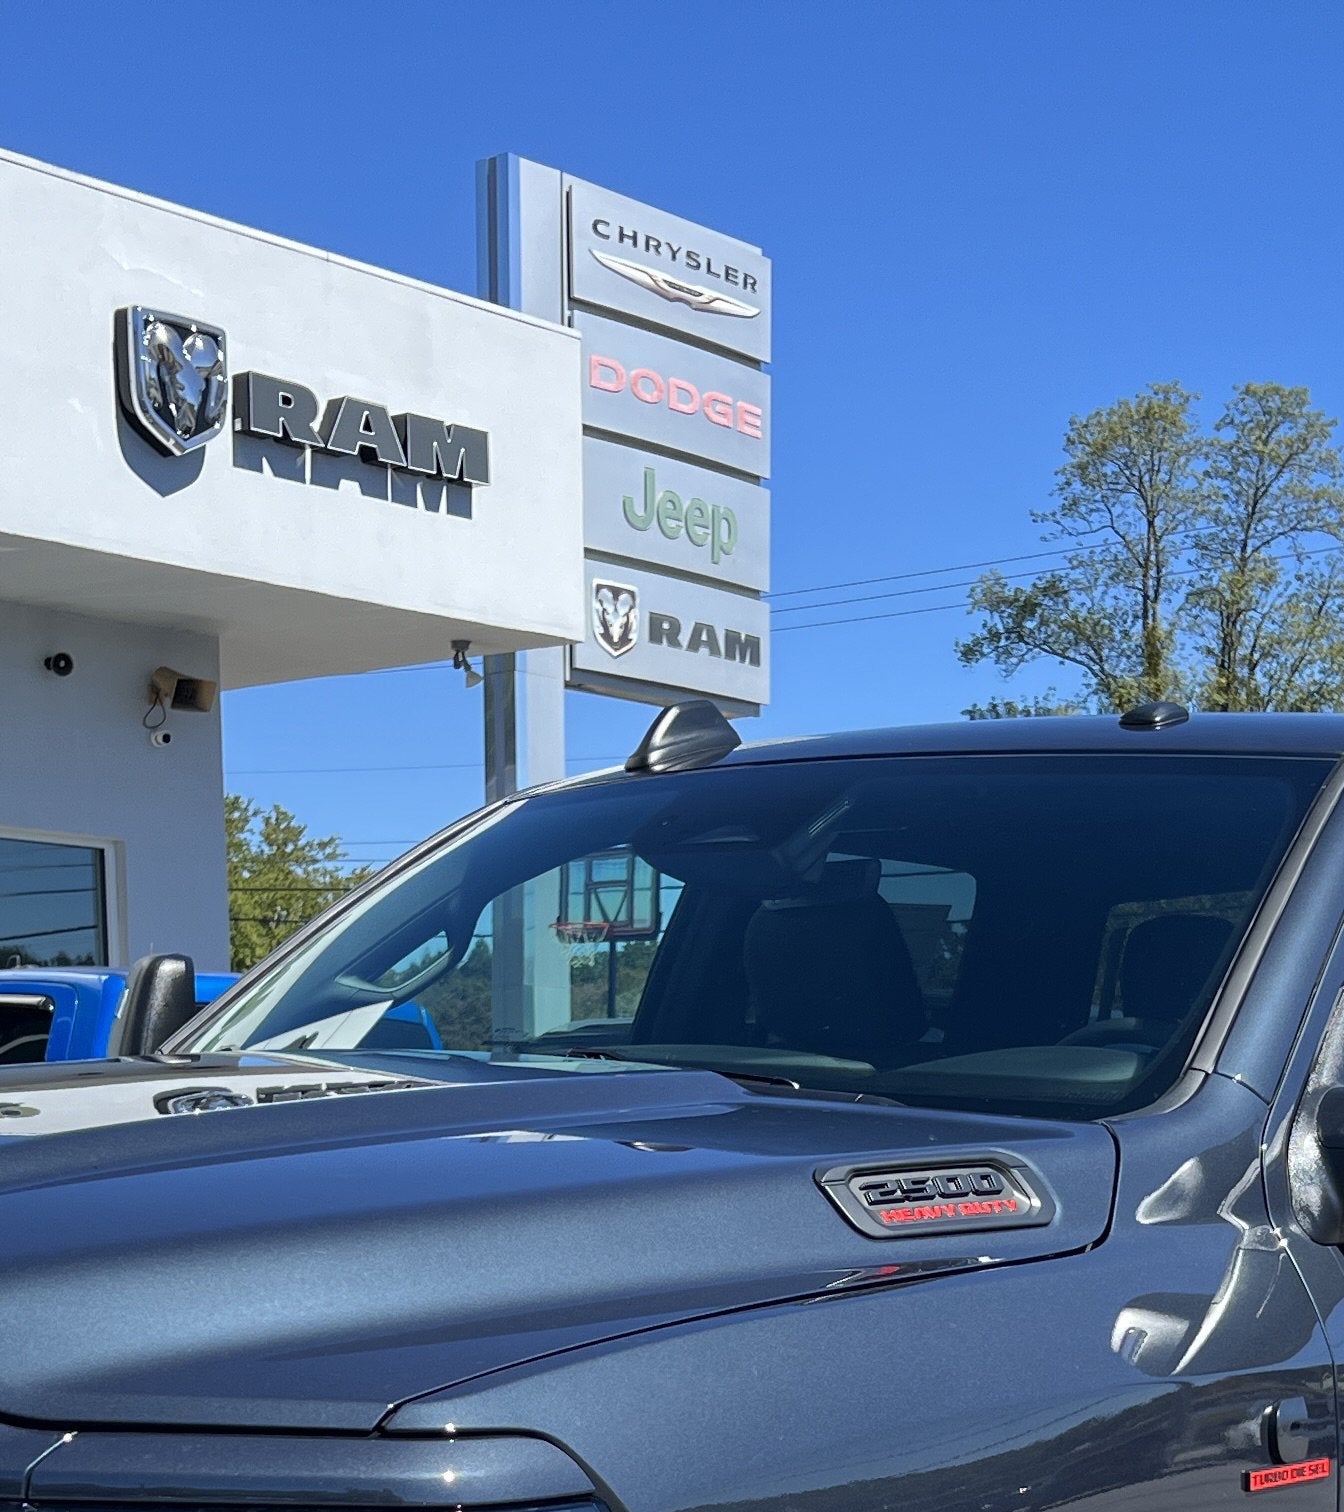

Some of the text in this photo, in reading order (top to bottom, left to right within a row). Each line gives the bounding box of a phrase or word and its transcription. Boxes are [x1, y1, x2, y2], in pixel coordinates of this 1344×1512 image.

[591, 218, 758, 294] CHRYSLER
[232, 370, 491, 486] RAM
[589, 352, 762, 439] DODGE
[622, 466, 739, 565] Jeep
[648, 611, 761, 668] RAM
[859, 1172, 1006, 1206] 2500
[880, 1199, 1017, 1224] HEAVY DUTY
